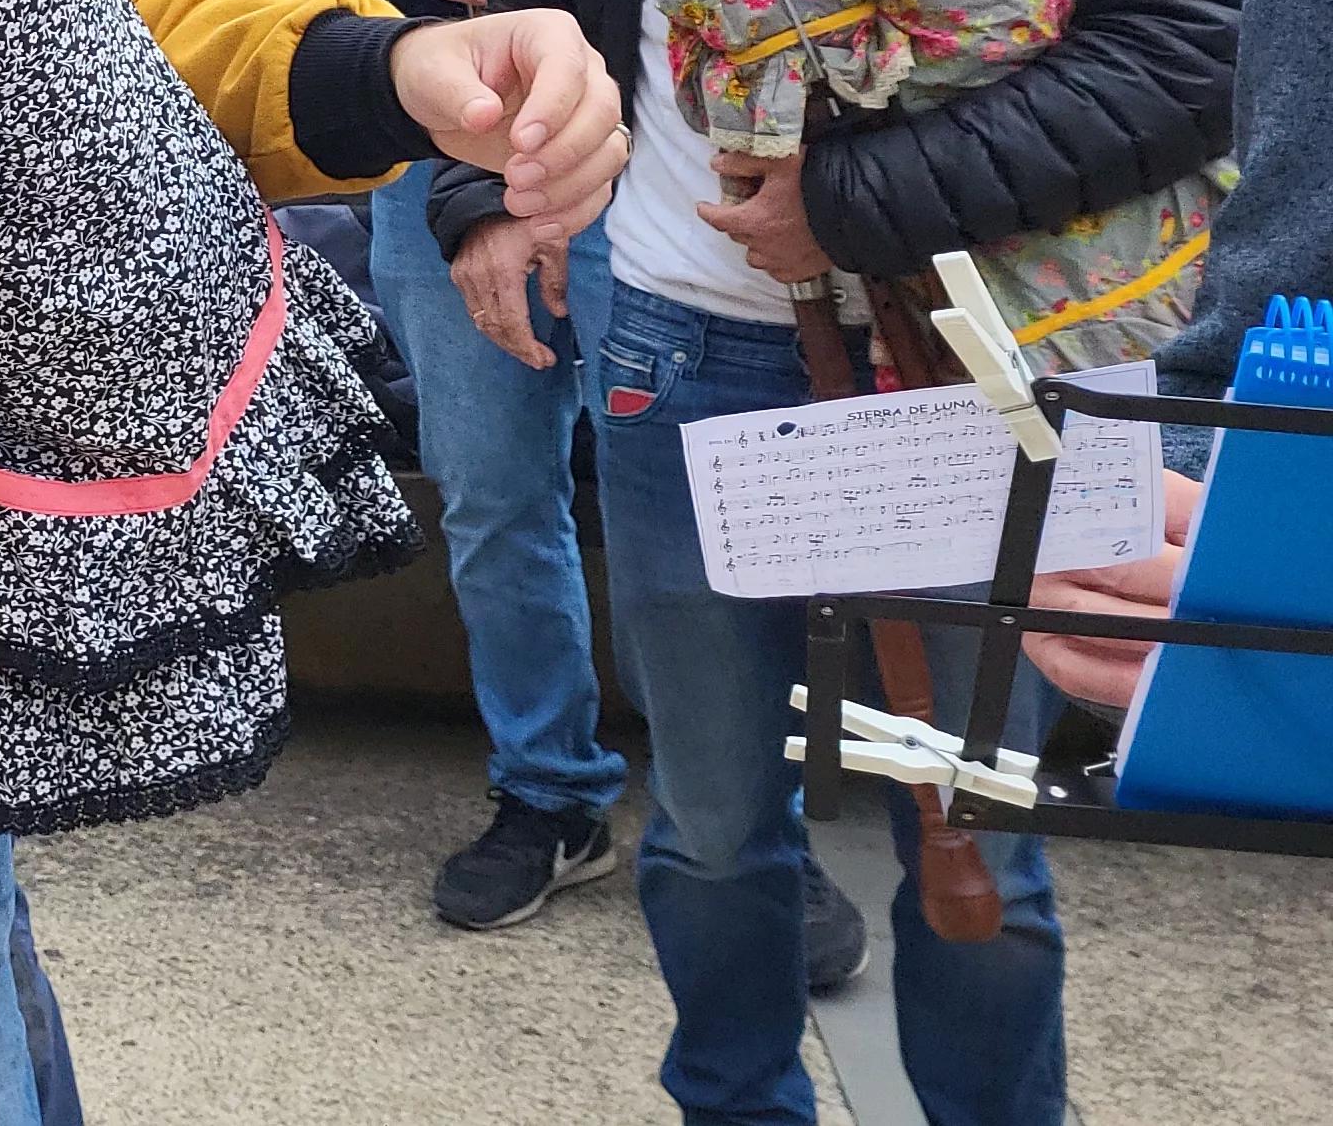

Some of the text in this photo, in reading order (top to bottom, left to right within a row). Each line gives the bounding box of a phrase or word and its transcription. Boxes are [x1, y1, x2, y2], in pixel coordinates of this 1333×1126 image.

[847, 399, 978, 421] SIERRA DE LUNA
